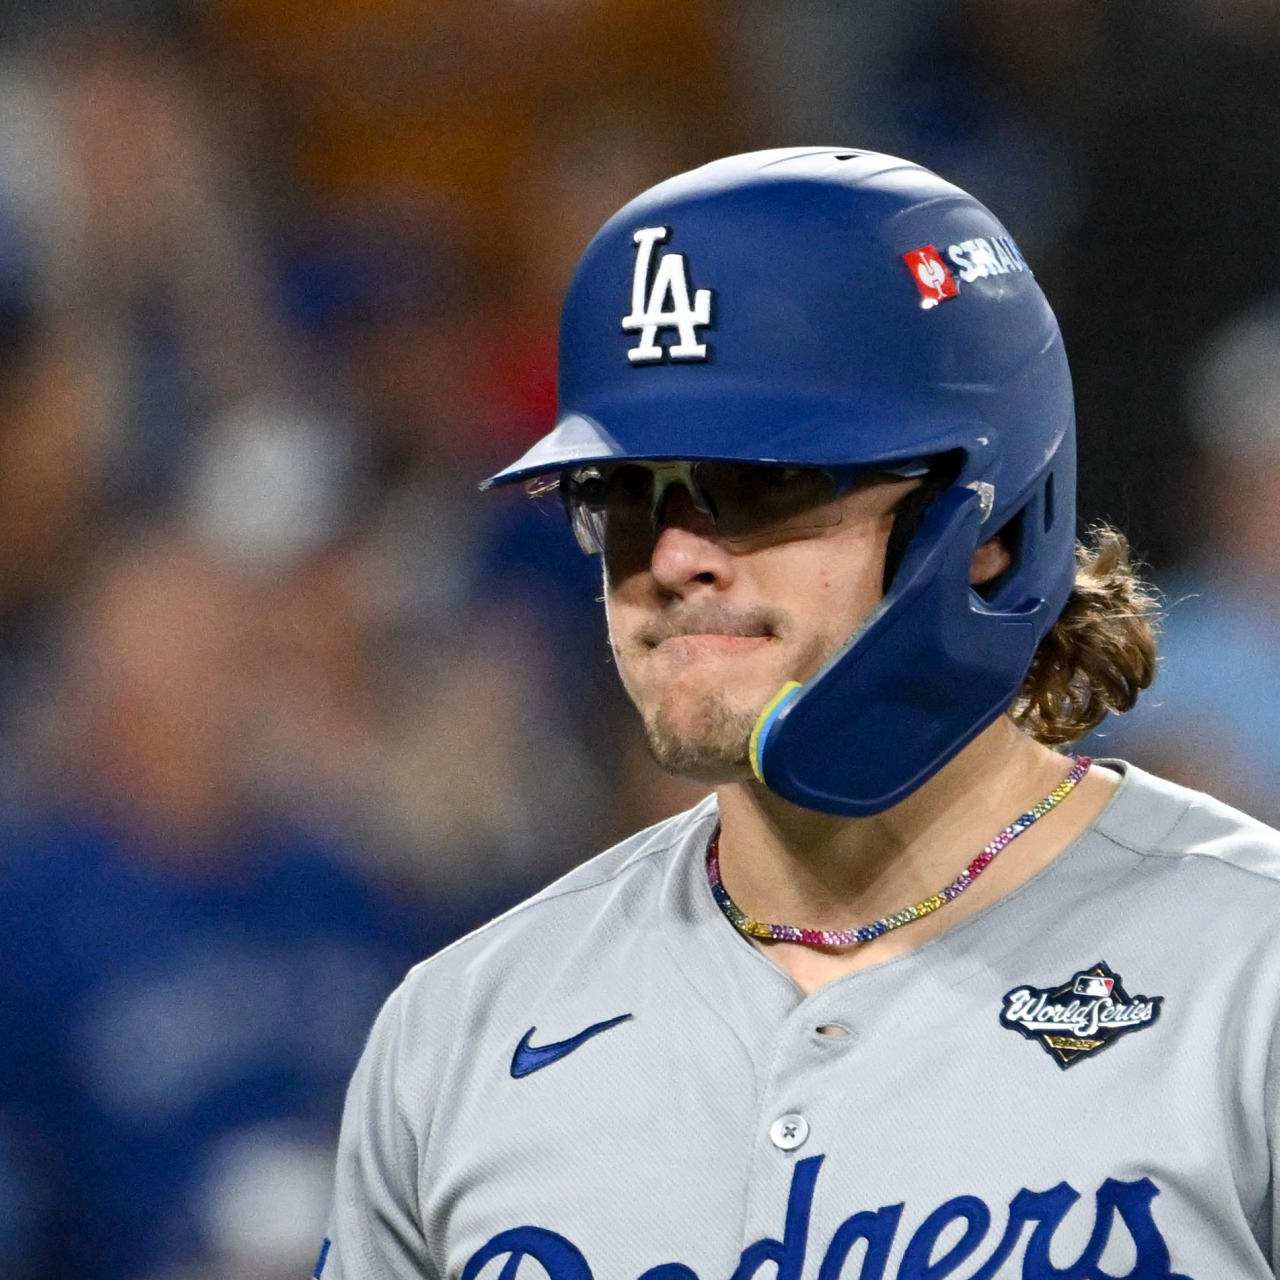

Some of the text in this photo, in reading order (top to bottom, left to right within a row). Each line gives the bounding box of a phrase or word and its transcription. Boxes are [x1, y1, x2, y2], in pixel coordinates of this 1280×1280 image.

[622, 226, 711, 361] LA
[1006, 989, 1152, 1037] World Series
